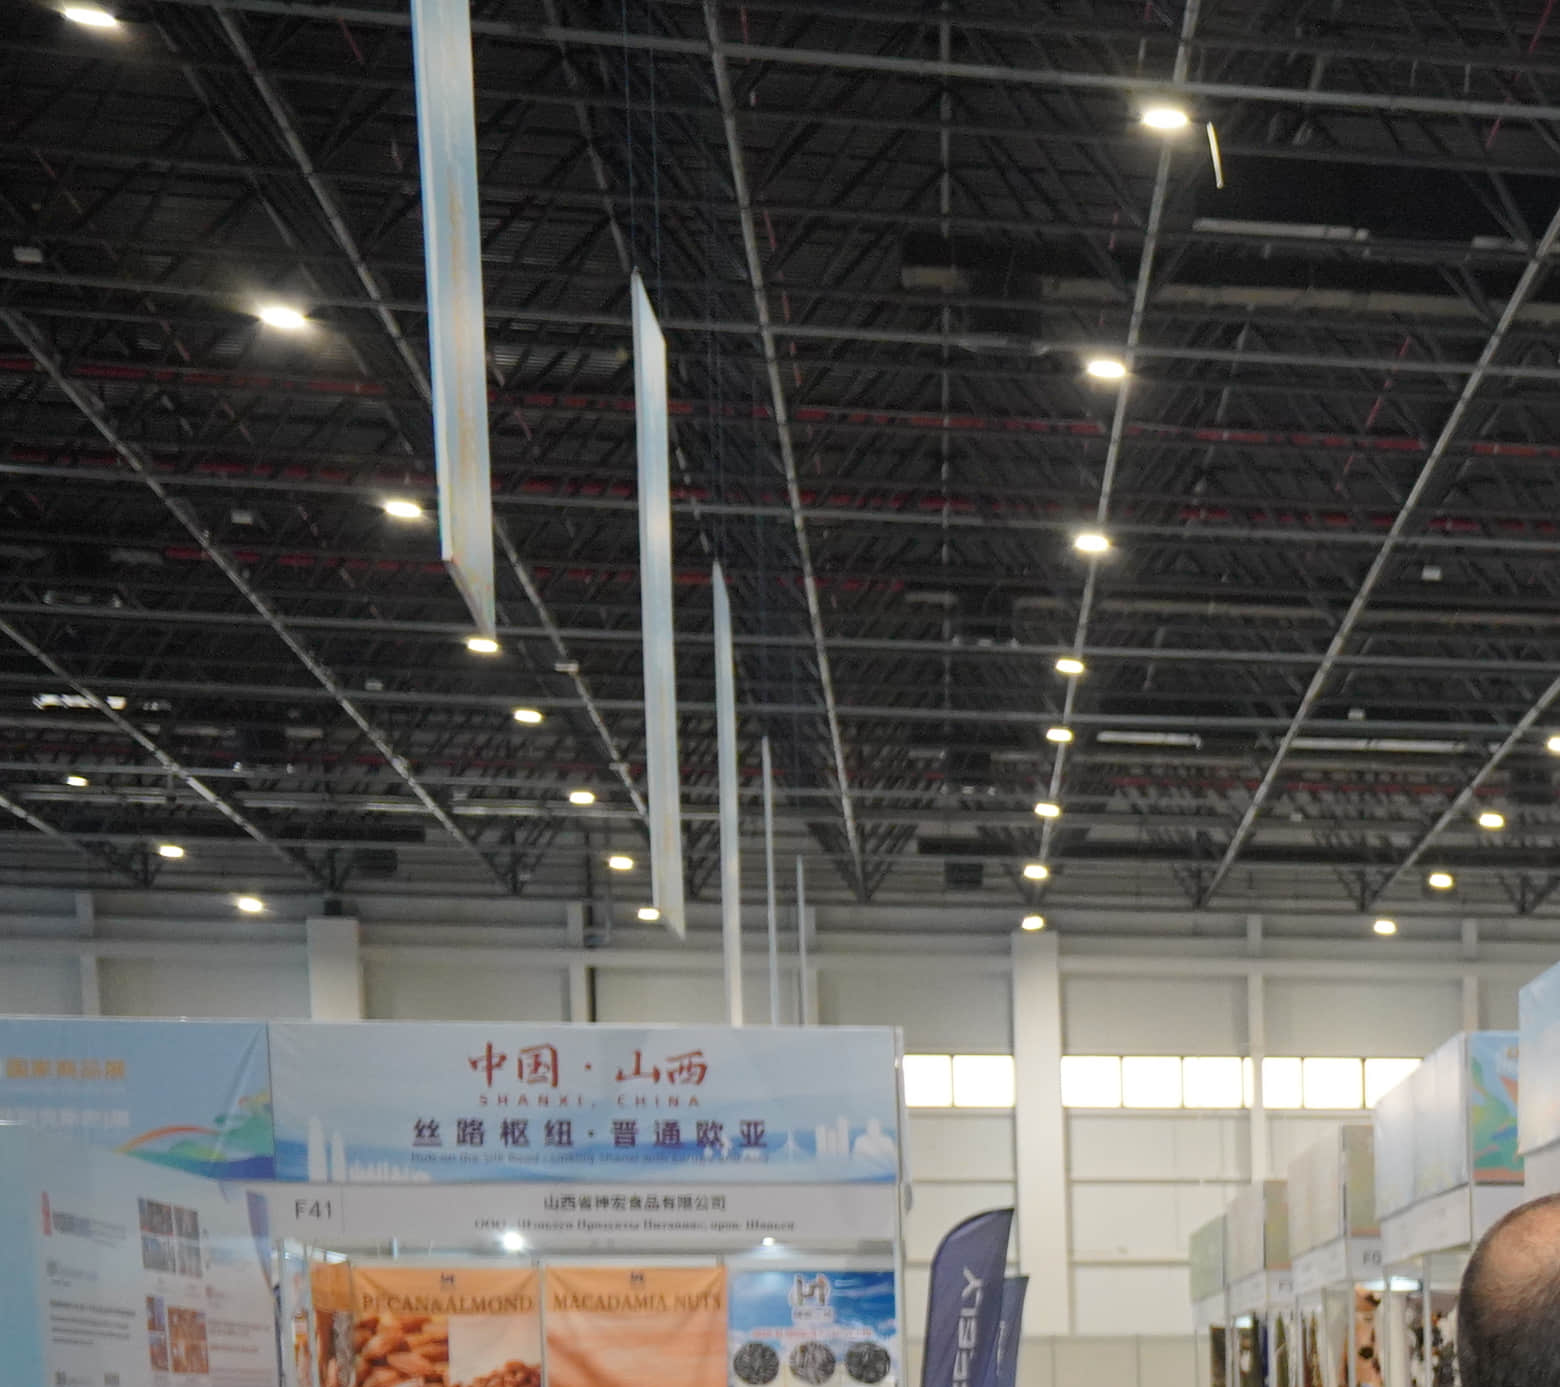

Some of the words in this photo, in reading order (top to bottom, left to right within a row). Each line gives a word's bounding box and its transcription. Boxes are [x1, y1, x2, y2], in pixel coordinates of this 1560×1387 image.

[617, 1095, 701, 1108] CHINA
[553, 1293, 667, 1312] MACADAMIA
[674, 1293, 722, 1312] NUTS
